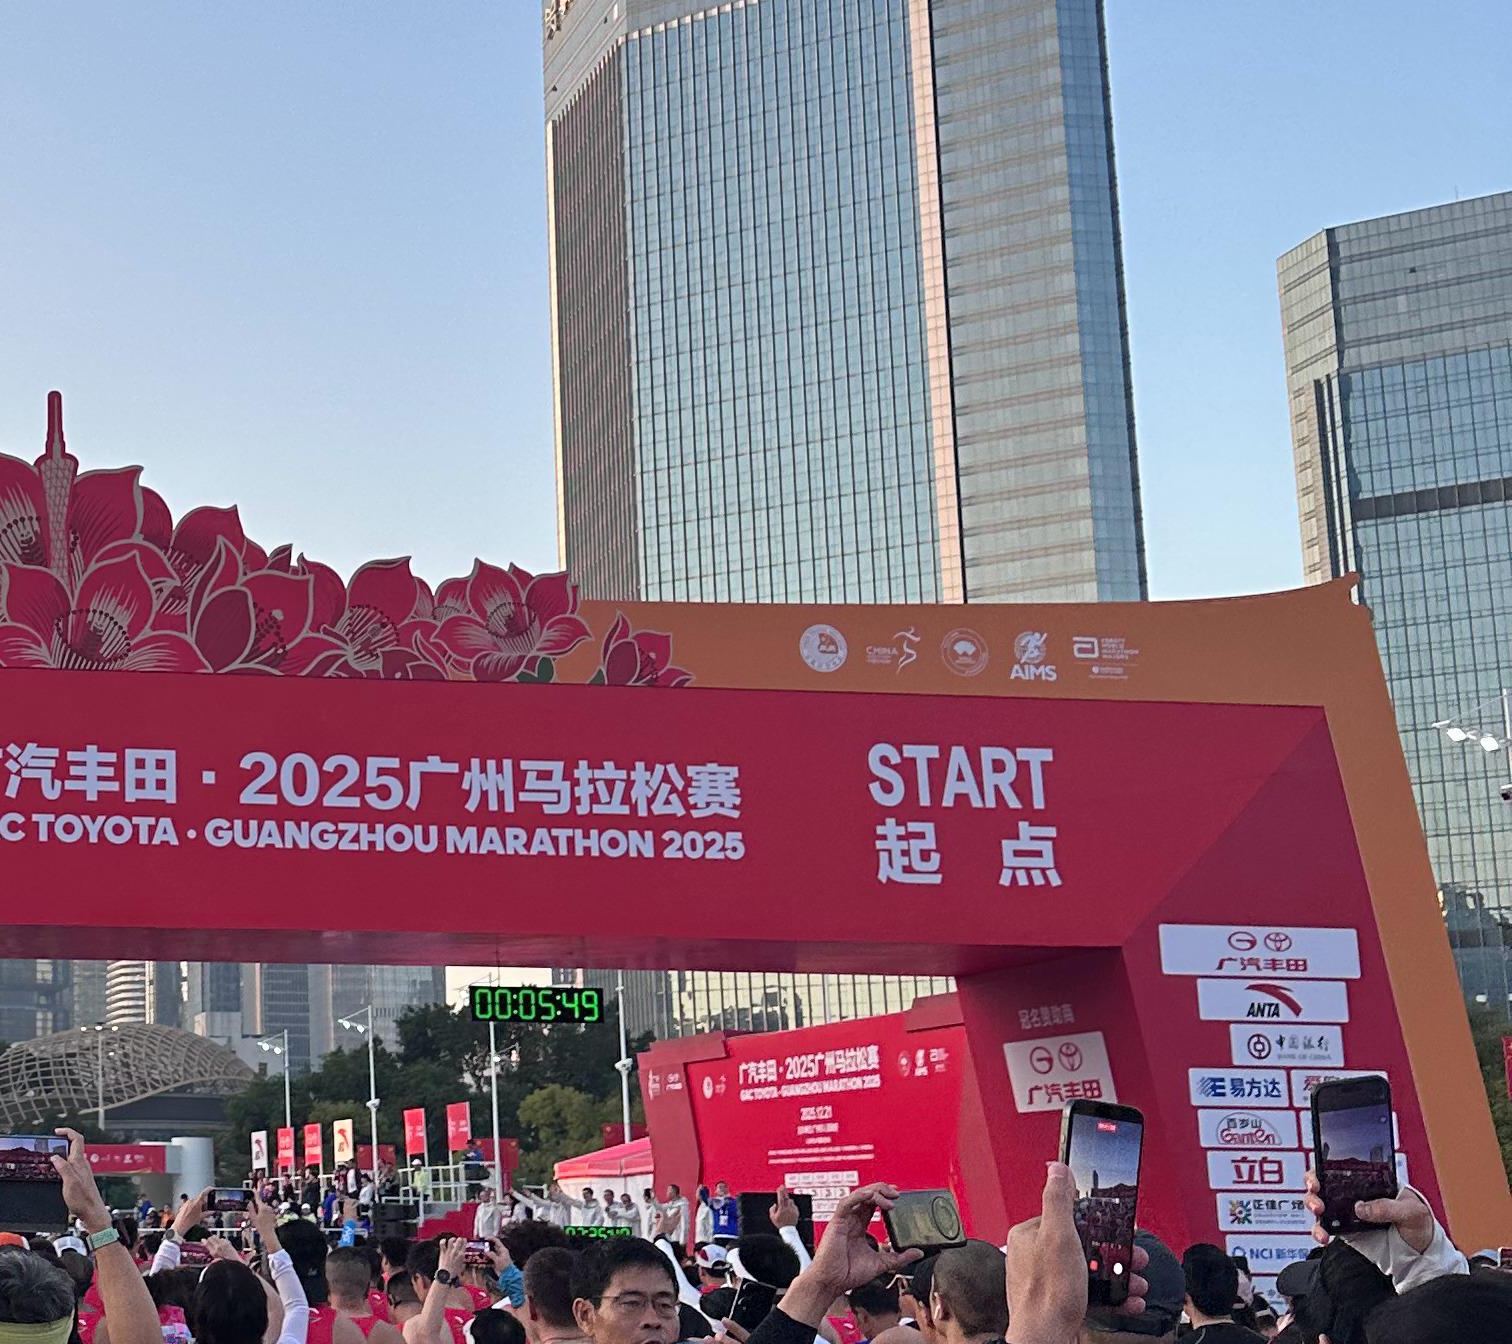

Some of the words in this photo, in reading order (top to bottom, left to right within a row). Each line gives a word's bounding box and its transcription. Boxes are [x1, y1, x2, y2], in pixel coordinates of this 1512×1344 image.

[1009, 664, 1057, 682] AIMS
[867, 743, 1054, 810] START
[32, 813, 179, 846] TOYOTA
[204, 818, 439, 854] GUANGZHOU
[445, 824, 655, 859] MARATHON
[661, 830, 746, 860] 2025
[875, 817, 1063, 887] 起点
[1215, 957, 1308, 972] 广汽丰田
[474, 989, 600, 1022] 00:05:49
[1246, 1002, 1281, 1018] ANTA
[1028, 1079, 1102, 1105] 广汽丰田
[1230, 1077, 1282, 1098] 易方达
[1226, 1117, 1263, 1129] 百岁山
[1230, 1156, 1285, 1185] 立白
[1253, 1199, 1305, 1210] 正佳广场
[1250, 1248, 1273, 1260] NCI
